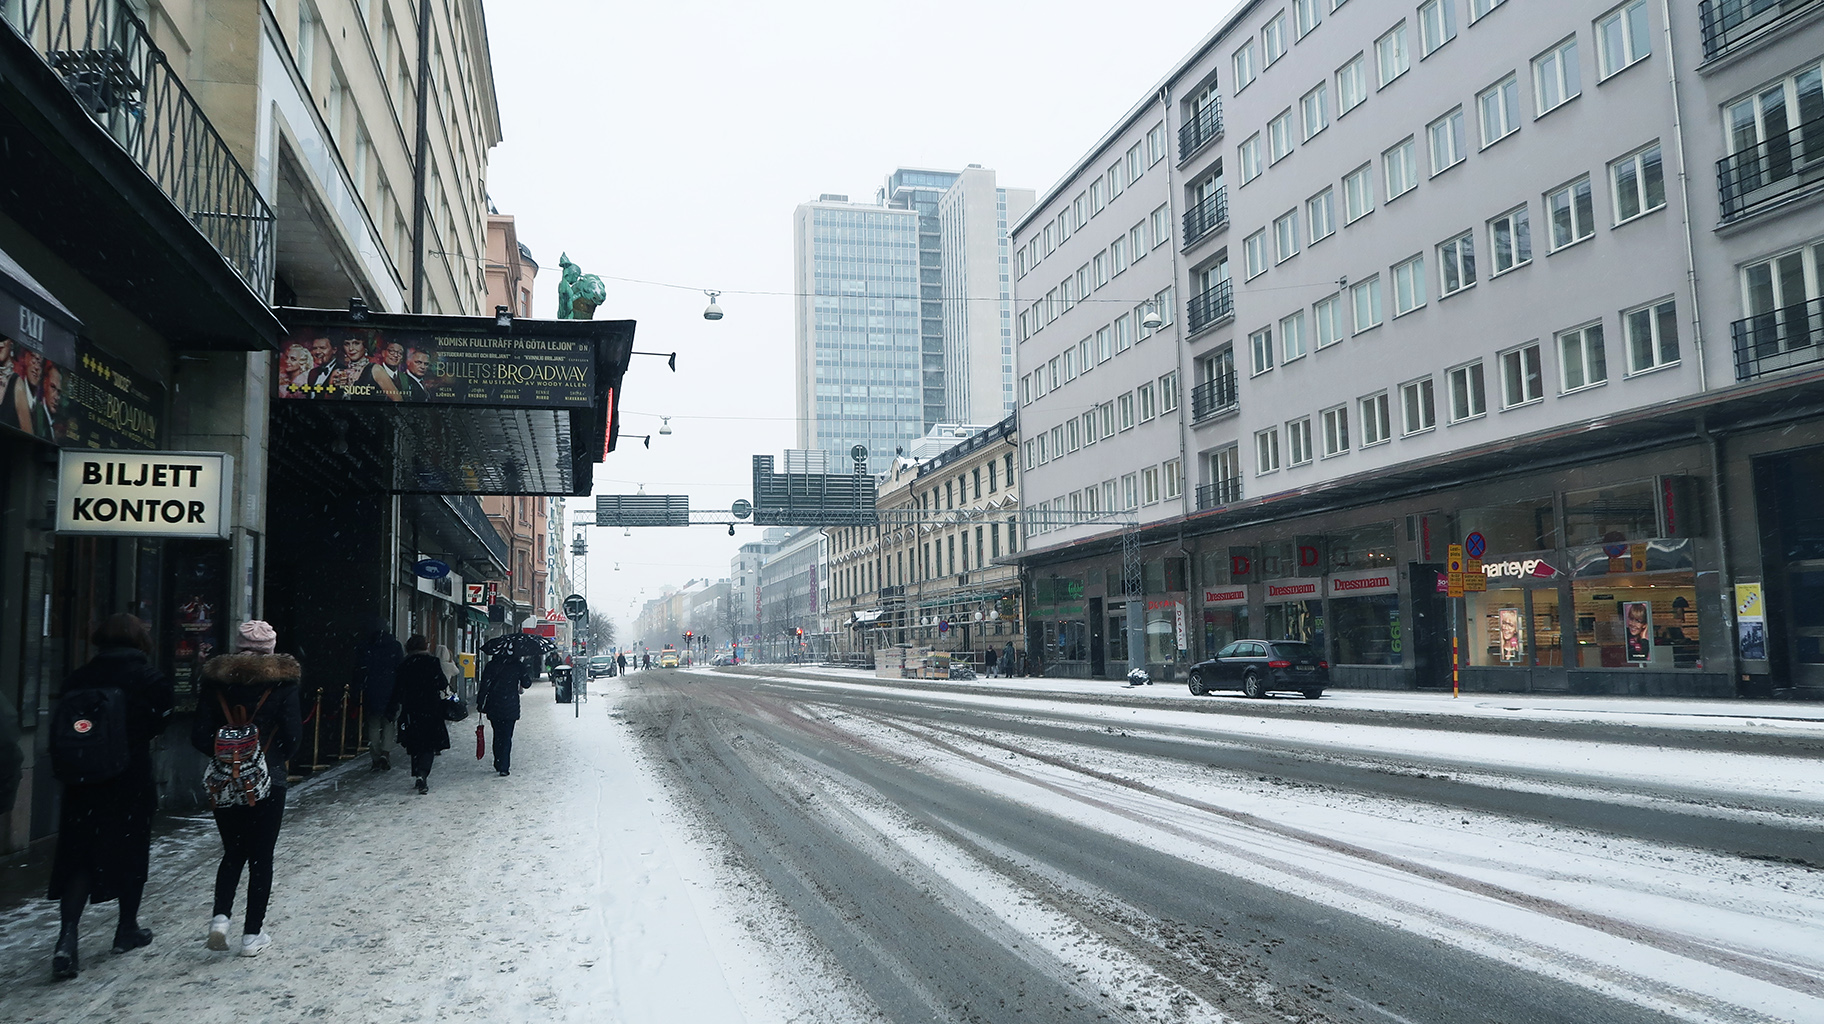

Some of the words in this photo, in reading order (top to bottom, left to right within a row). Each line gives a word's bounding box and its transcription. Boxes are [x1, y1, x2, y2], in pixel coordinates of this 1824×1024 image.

[19, 305, 46, 342] EXIT
[435, 337, 468, 347] "KOMISK
[514, 337, 524, 349] PÅ
[525, 339, 546, 350] GÖTA
[547, 341, 576, 351] LEJON"
[436, 361, 491, 379] BULLETS
[497, 363, 588, 384] BROADWAY
[83, 462, 202, 487] BILJETT
[73, 498, 205, 523] KONTOR
[547, 496, 556, 595] VICTORIA
[1232, 556, 1250, 575] D
[1299, 546, 1319, 567] D
[1481, 559, 1544, 579] marteyes
[1269, 583, 1316, 596] Dressmann
[1334, 576, 1390, 591] Dressmann
[469, 586, 482, 602] 7
[1206, 590, 1245, 602] Dressmann
